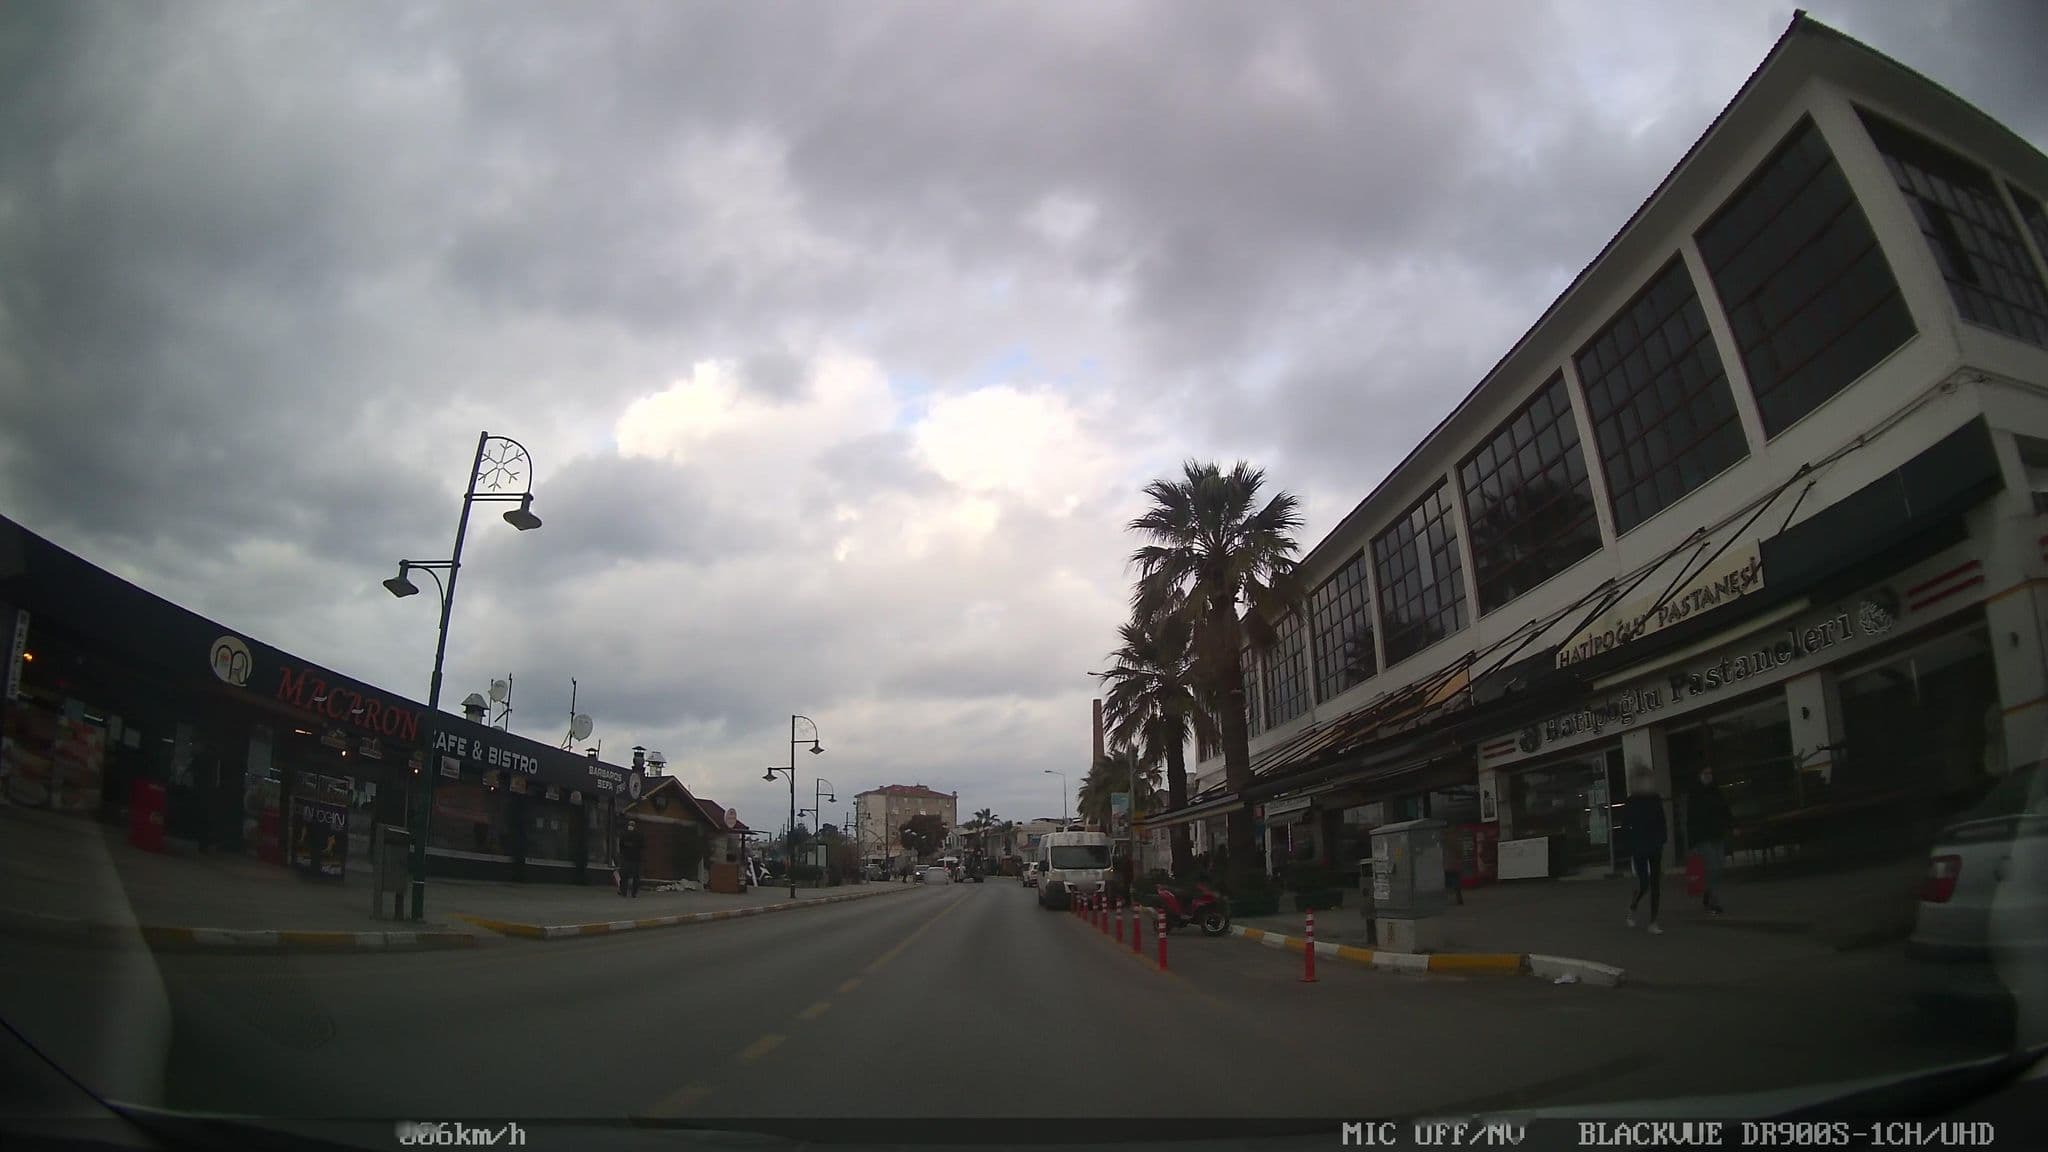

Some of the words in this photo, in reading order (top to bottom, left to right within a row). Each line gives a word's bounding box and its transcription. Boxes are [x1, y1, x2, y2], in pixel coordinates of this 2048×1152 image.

[1658, 556, 1762, 627] PASTANESİ
[276, 665, 423, 742] MACARON
[472, 740, 483, 761] &
[488, 746, 539, 775] BISTRO
